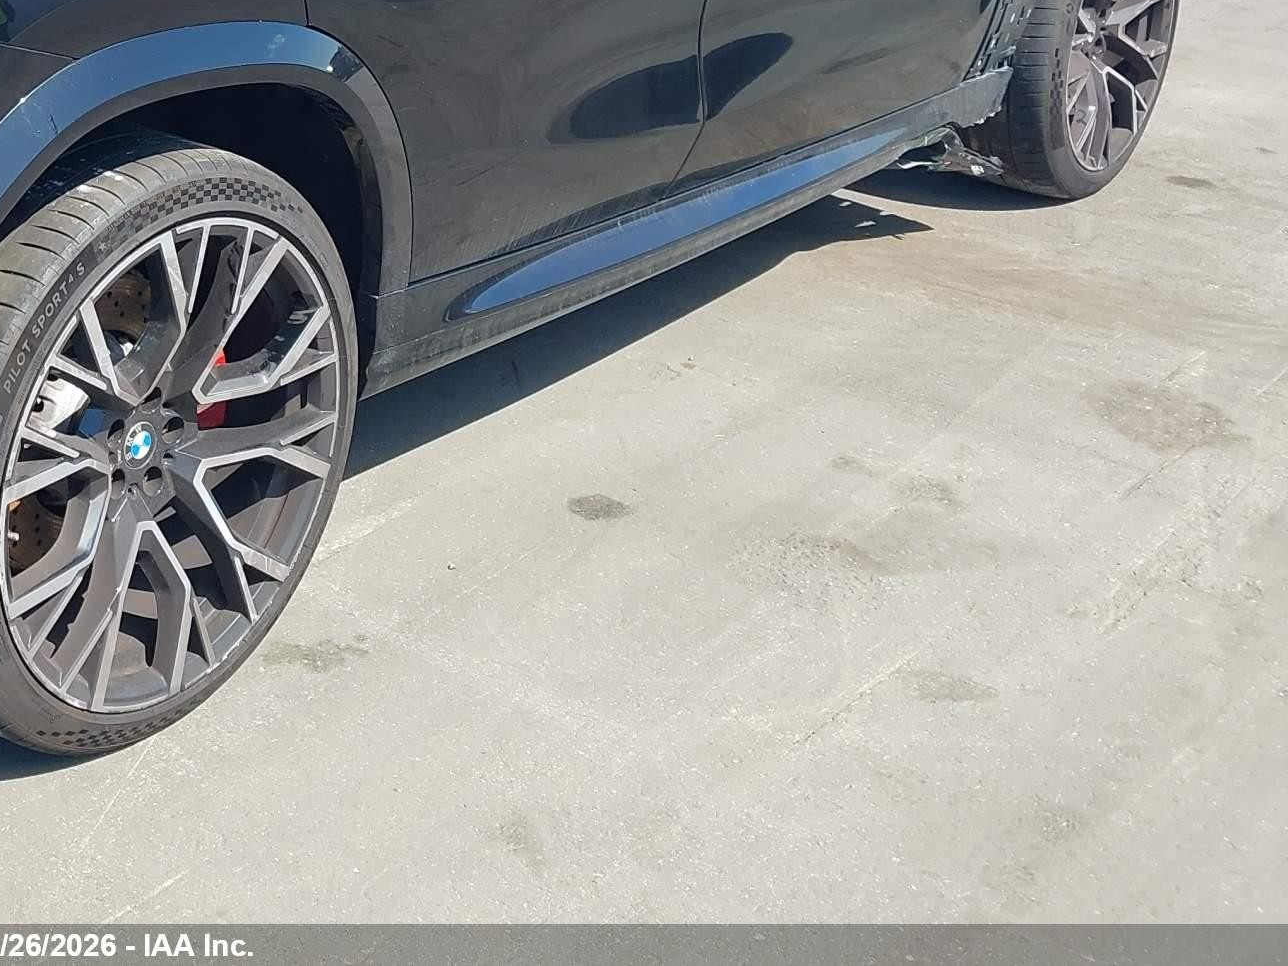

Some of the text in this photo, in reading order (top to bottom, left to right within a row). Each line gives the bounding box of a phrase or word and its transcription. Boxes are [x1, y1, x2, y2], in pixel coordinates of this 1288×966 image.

[3, 344, 32, 394] PILOT
[31, 284, 69, 338] SPORT
[76, 262, 86, 276] S
